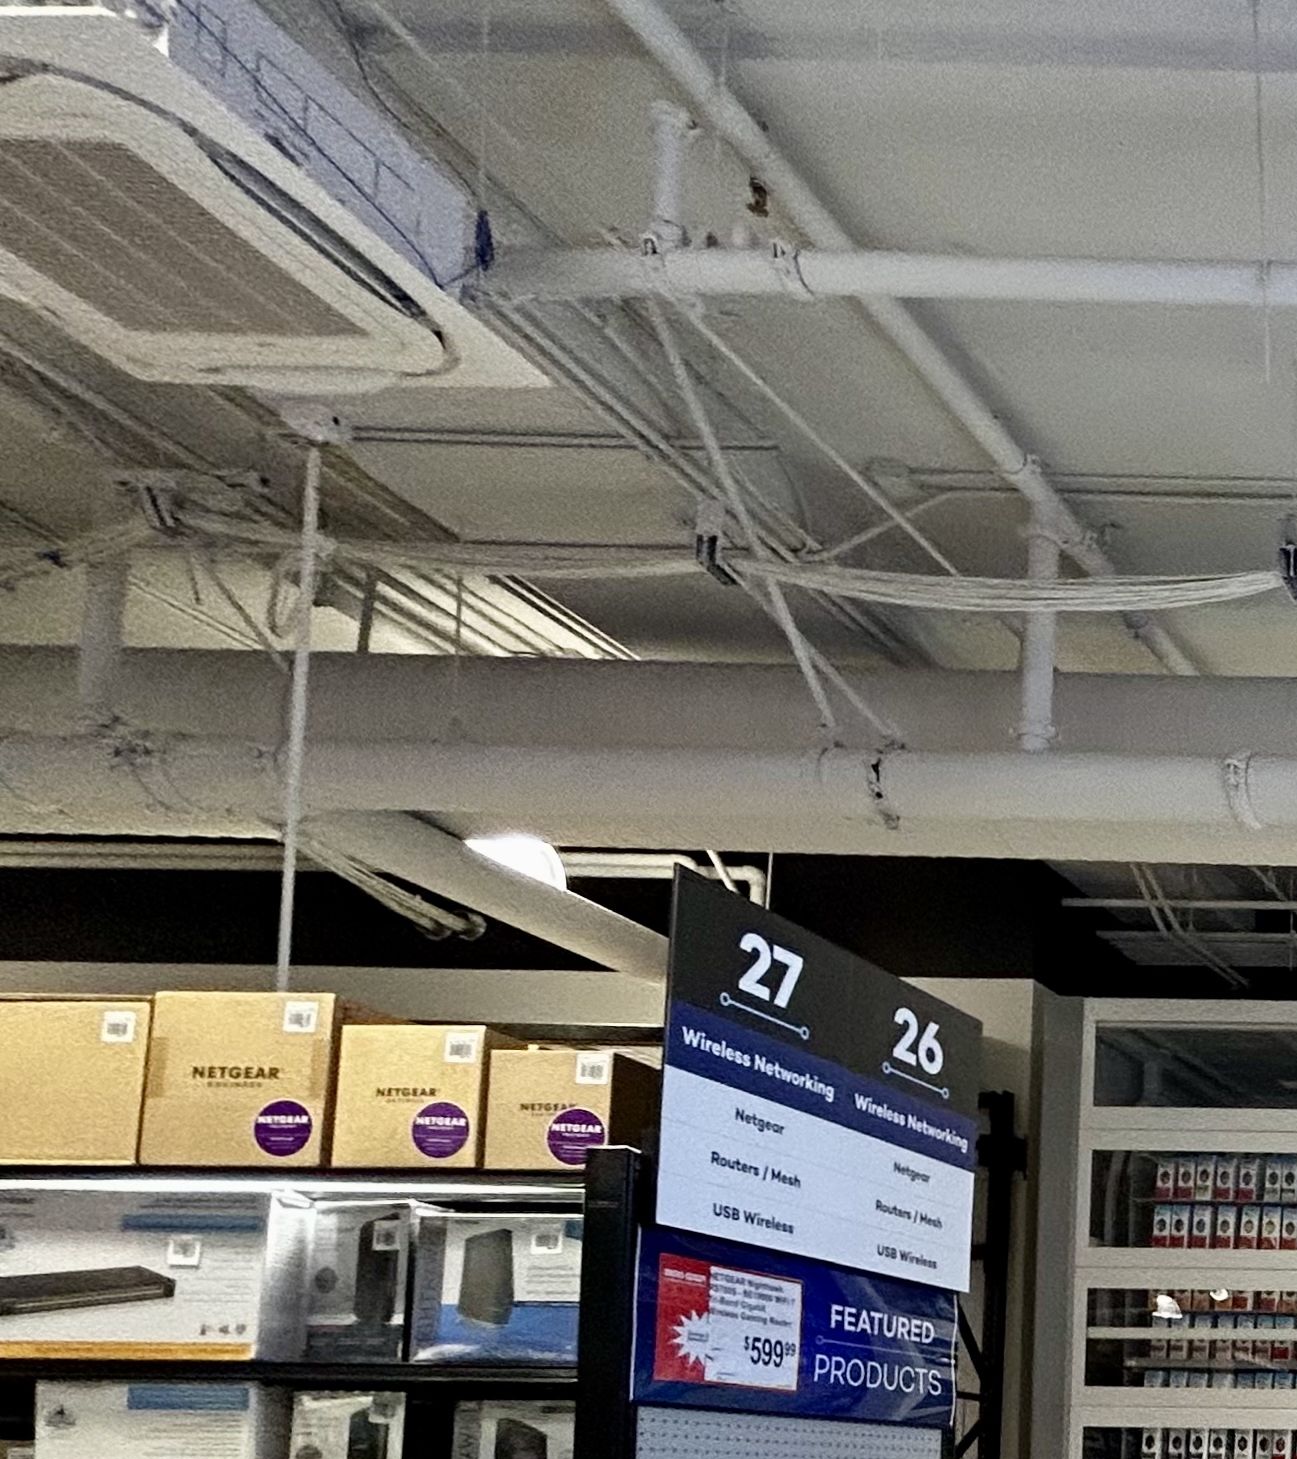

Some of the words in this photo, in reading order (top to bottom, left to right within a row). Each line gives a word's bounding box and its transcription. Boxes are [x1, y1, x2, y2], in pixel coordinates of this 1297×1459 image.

[738, 932, 804, 1009] 27
[892, 1007, 944, 1075] 26
[192, 1066, 281, 1080] NETGEAR
[681, 1025, 751, 1067] Wireless
[754, 1053, 835, 1103] Networking
[376, 1087, 439, 1098] NETGEAR
[257, 1115, 310, 1126] NETGEAR
[415, 1115, 467, 1127] NETGEAR
[551, 1122, 602, 1134] NETGEAR
[734, 1107, 785, 1136] Netgear
[854, 1092, 906, 1127] Wireless
[907, 1114, 969, 1154] Networking
[710, 1150, 760, 1178] Routers
[762, 1165, 769, 1180] /
[770, 1170, 801, 1189] Mesh
[893, 1161, 931, 1184] Netgear
[712, 1202, 740, 1222] USB
[742, 1210, 795, 1235] Wireless
[875, 1199, 912, 1221] Routers
[919, 1213, 943, 1230] Mesh
[876, 1244, 898, 1260] USB
[899, 1247, 938, 1270] Wireless
[830, 1303, 936, 1344] FEATURED
[813, 1353, 942, 1396] PRODUCTS
